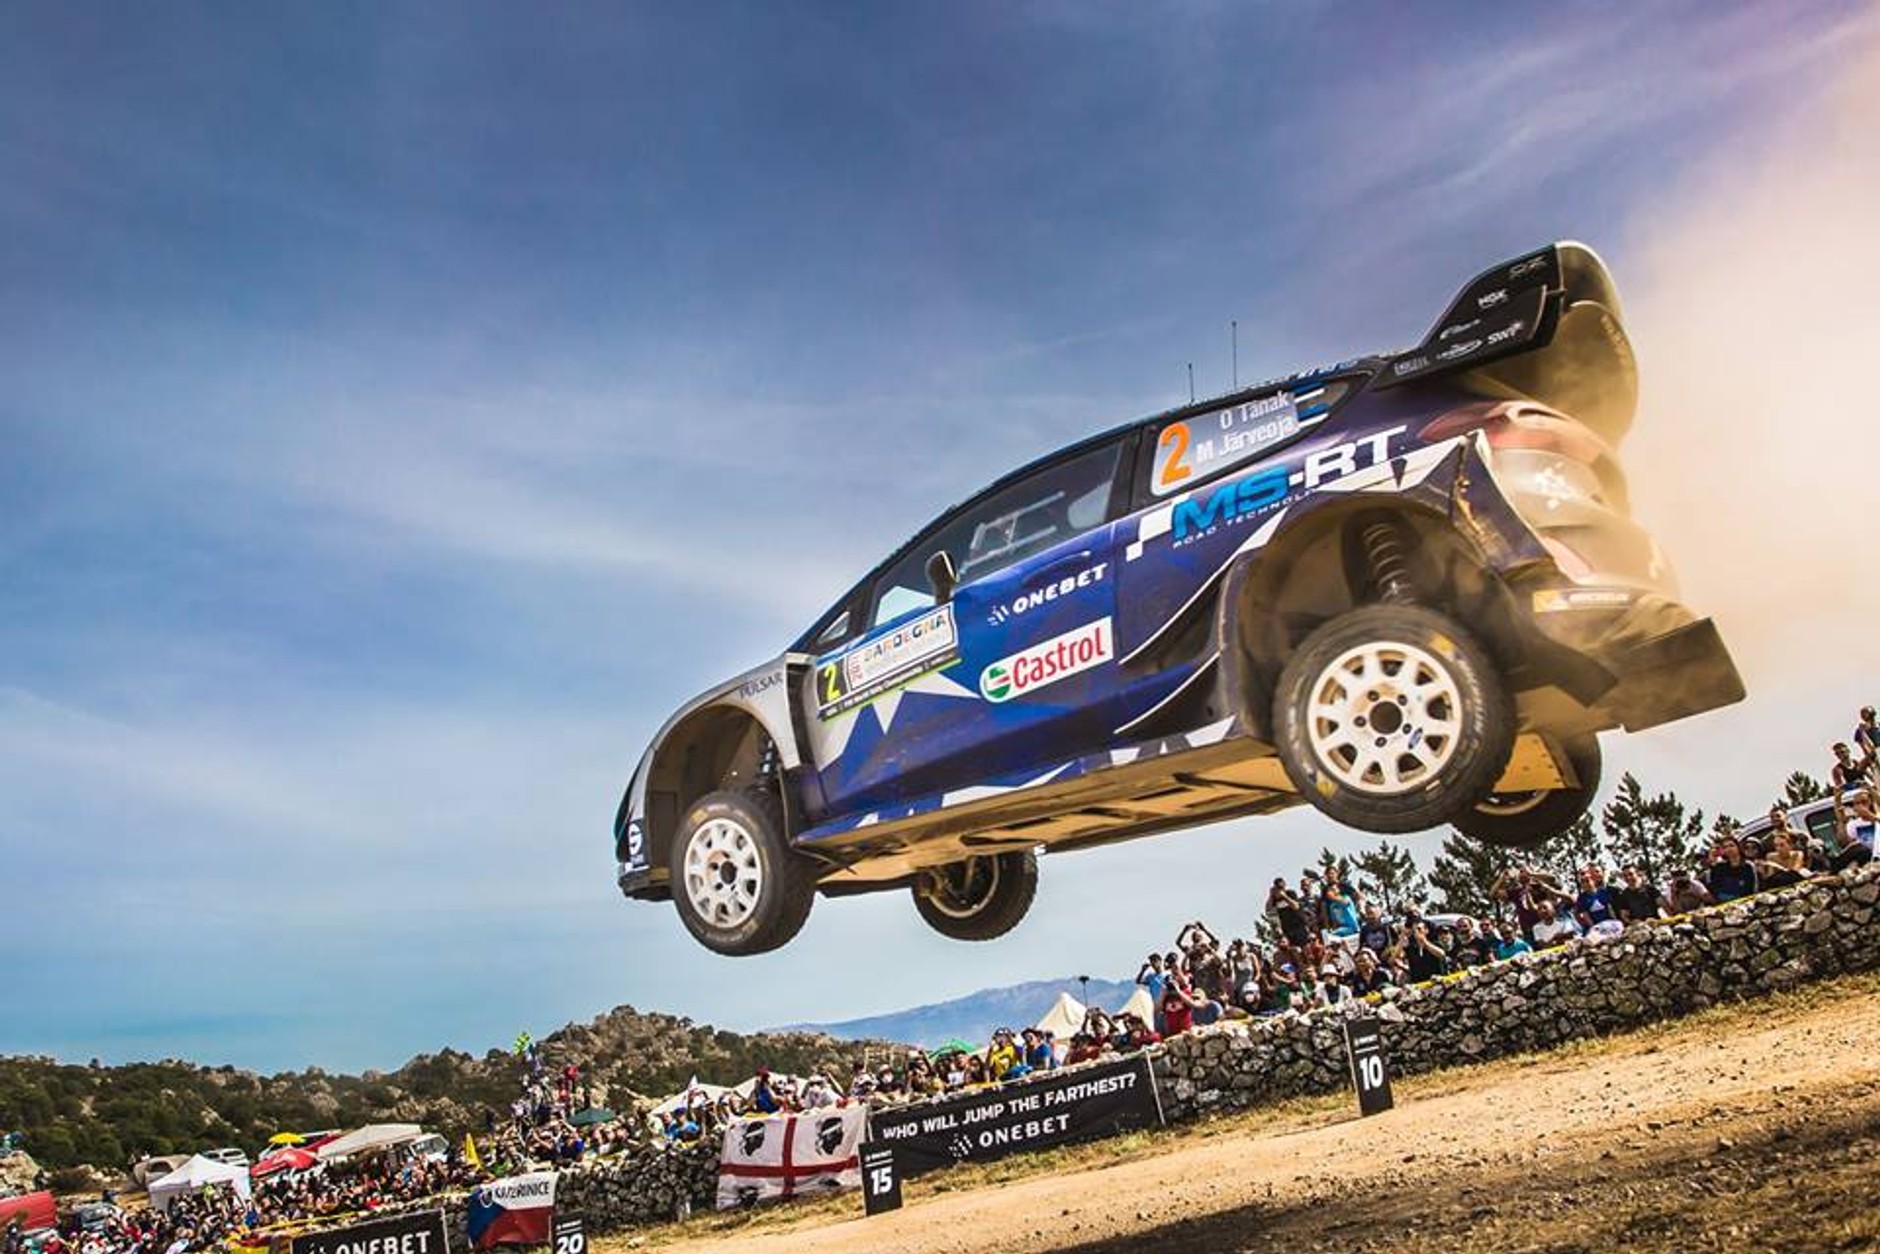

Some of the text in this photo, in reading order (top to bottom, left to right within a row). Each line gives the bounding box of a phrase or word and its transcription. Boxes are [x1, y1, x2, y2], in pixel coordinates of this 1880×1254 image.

[1160, 421, 1191, 486] 2
[1196, 440, 1214, 463] M
[1012, 563, 1108, 614] ONEBET
[1013, 627, 1105, 689] Castrol
[824, 661, 841, 702] 2
[1360, 1055, 1383, 1091] 10
[883, 1072, 1136, 1139] WHO WILL JUMP THE FARTHEST?
[979, 1113, 1070, 1148] ONEBET
[871, 1166, 892, 1195] 15
[556, 1233, 583, 1254] 20
